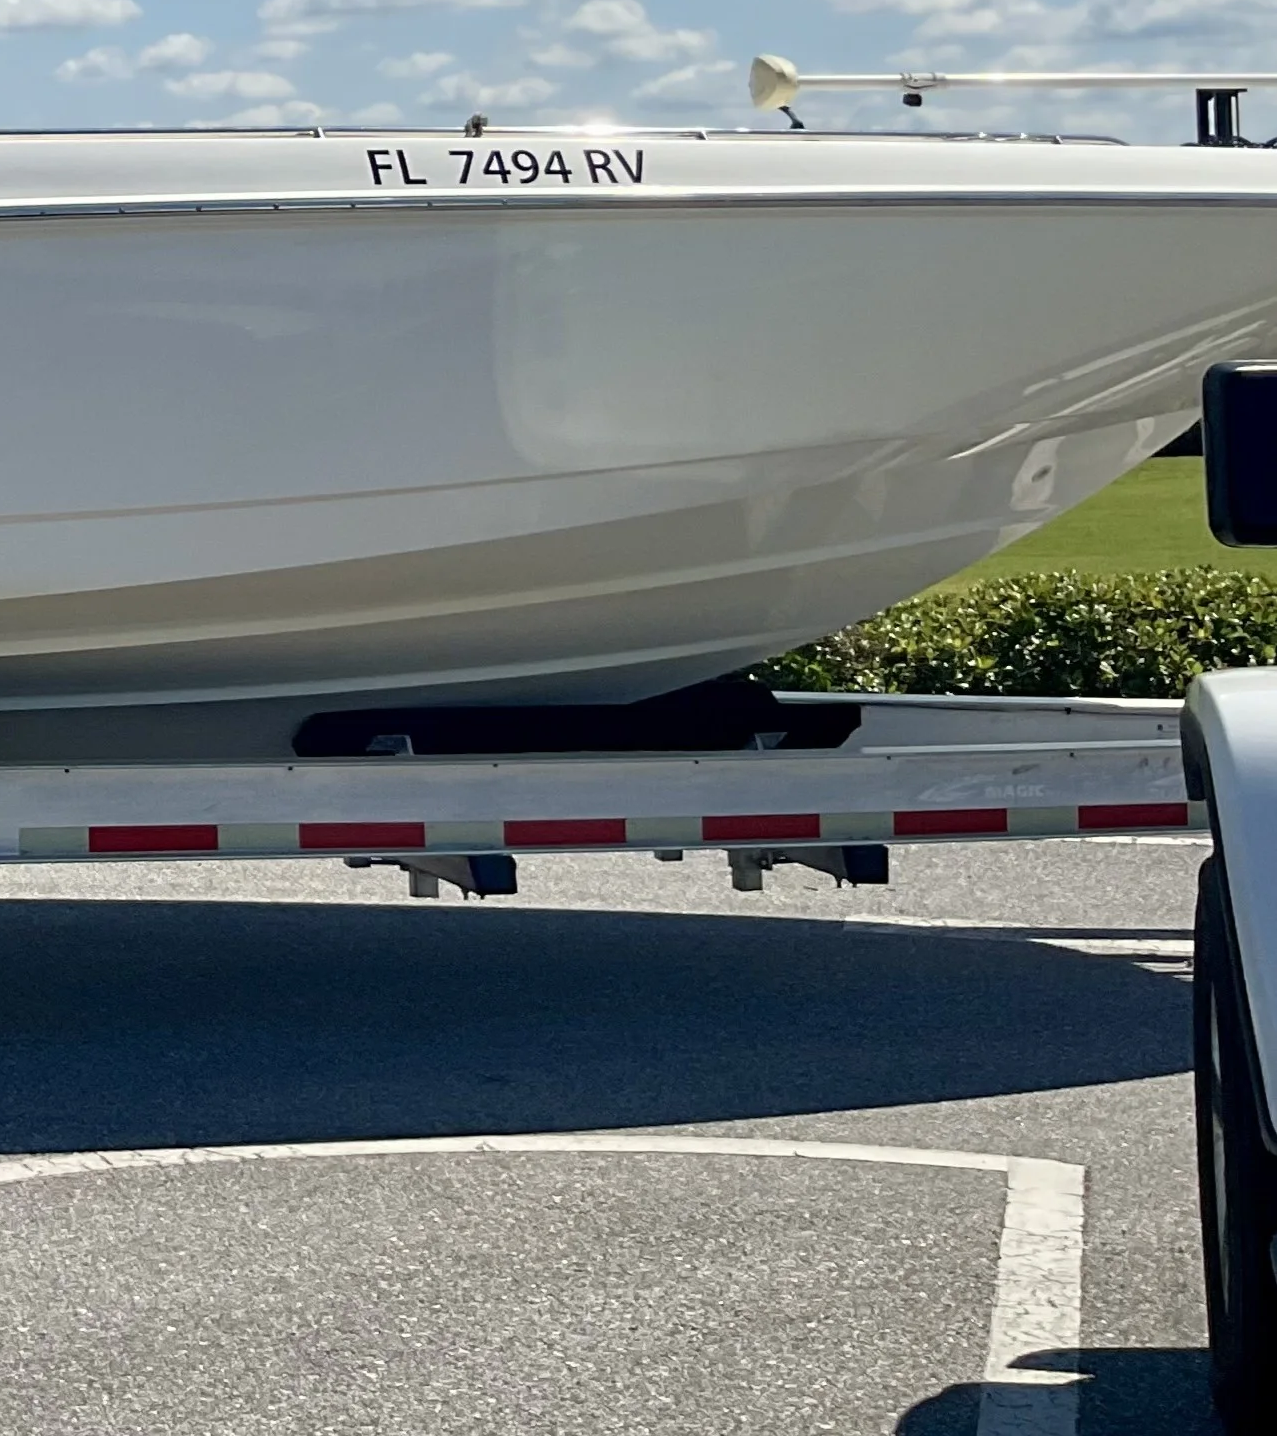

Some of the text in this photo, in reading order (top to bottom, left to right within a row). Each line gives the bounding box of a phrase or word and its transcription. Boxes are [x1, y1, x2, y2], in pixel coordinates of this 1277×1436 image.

[366, 149, 644, 185] FL 7494 RV
